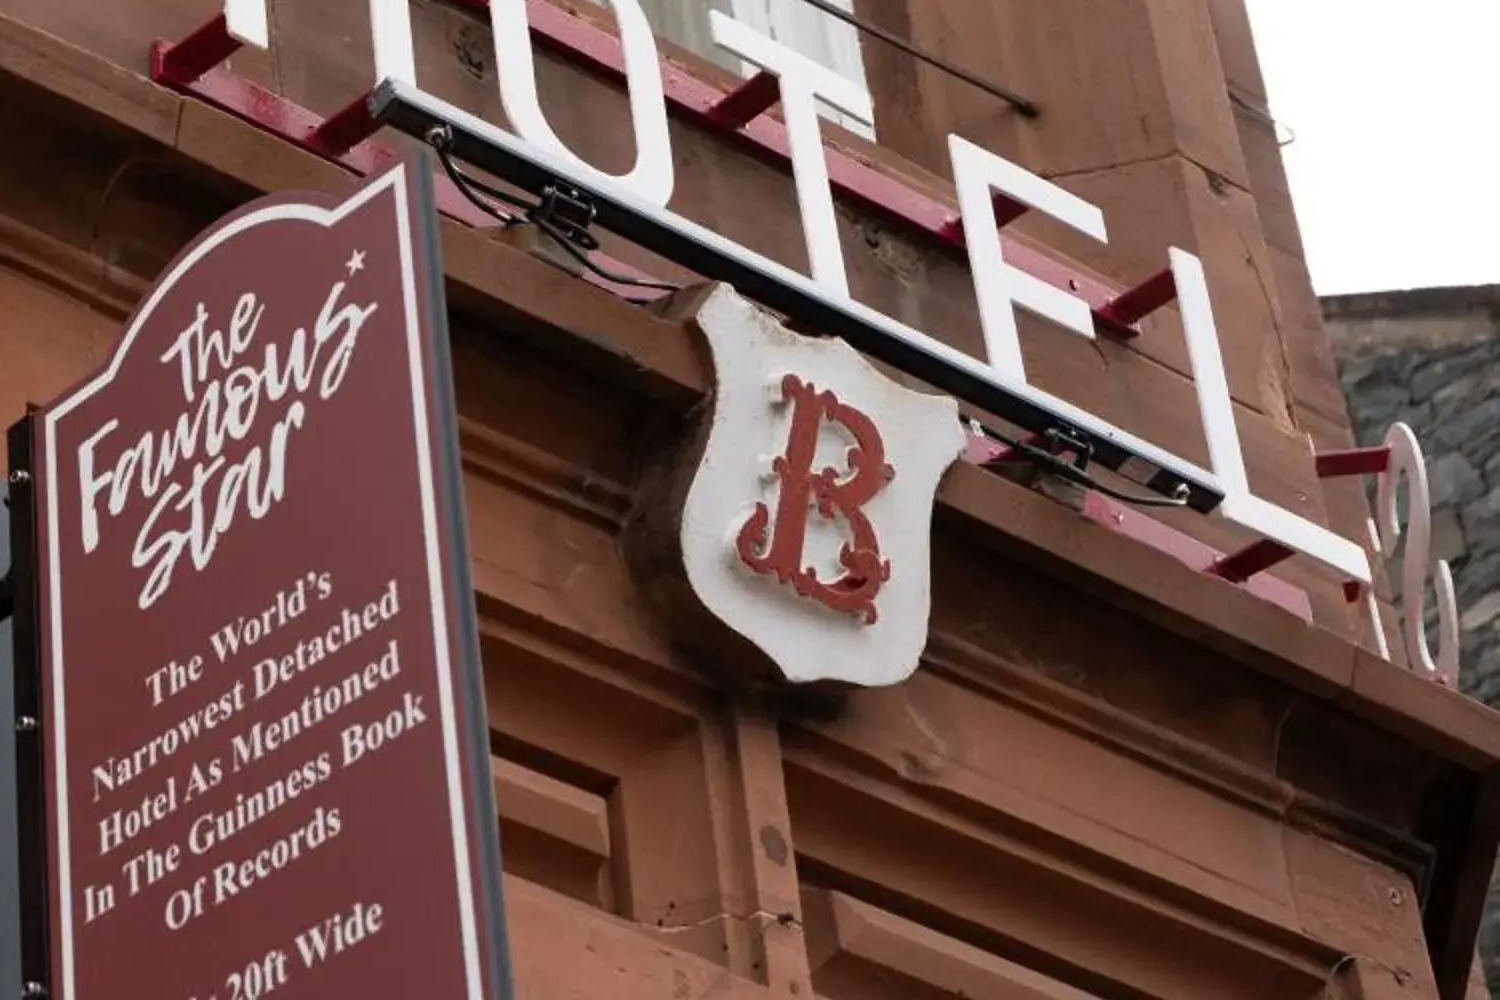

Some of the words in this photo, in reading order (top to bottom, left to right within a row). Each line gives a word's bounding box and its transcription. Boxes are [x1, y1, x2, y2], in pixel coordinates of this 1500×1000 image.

[77, 281, 378, 555] Famous
[160, 292, 266, 402] The
[131, 401, 305, 610] Star
[91, 680, 245, 802] Narrowest
[252, 579, 400, 701] Detached
[145, 653, 203, 707] The
[208, 571, 332, 663] World's
[83, 883, 116, 924] In
[121, 842, 181, 897] The
[188, 752, 331, 855] Guinness
[340, 692, 428, 769] Book
[98, 777, 177, 856] Hotel
[184, 757, 223, 802] As
[231, 639, 401, 773] Mentioned
[165, 876, 207, 930] Of
[212, 806, 341, 906] Records
[294, 902, 384, 969] Wide
